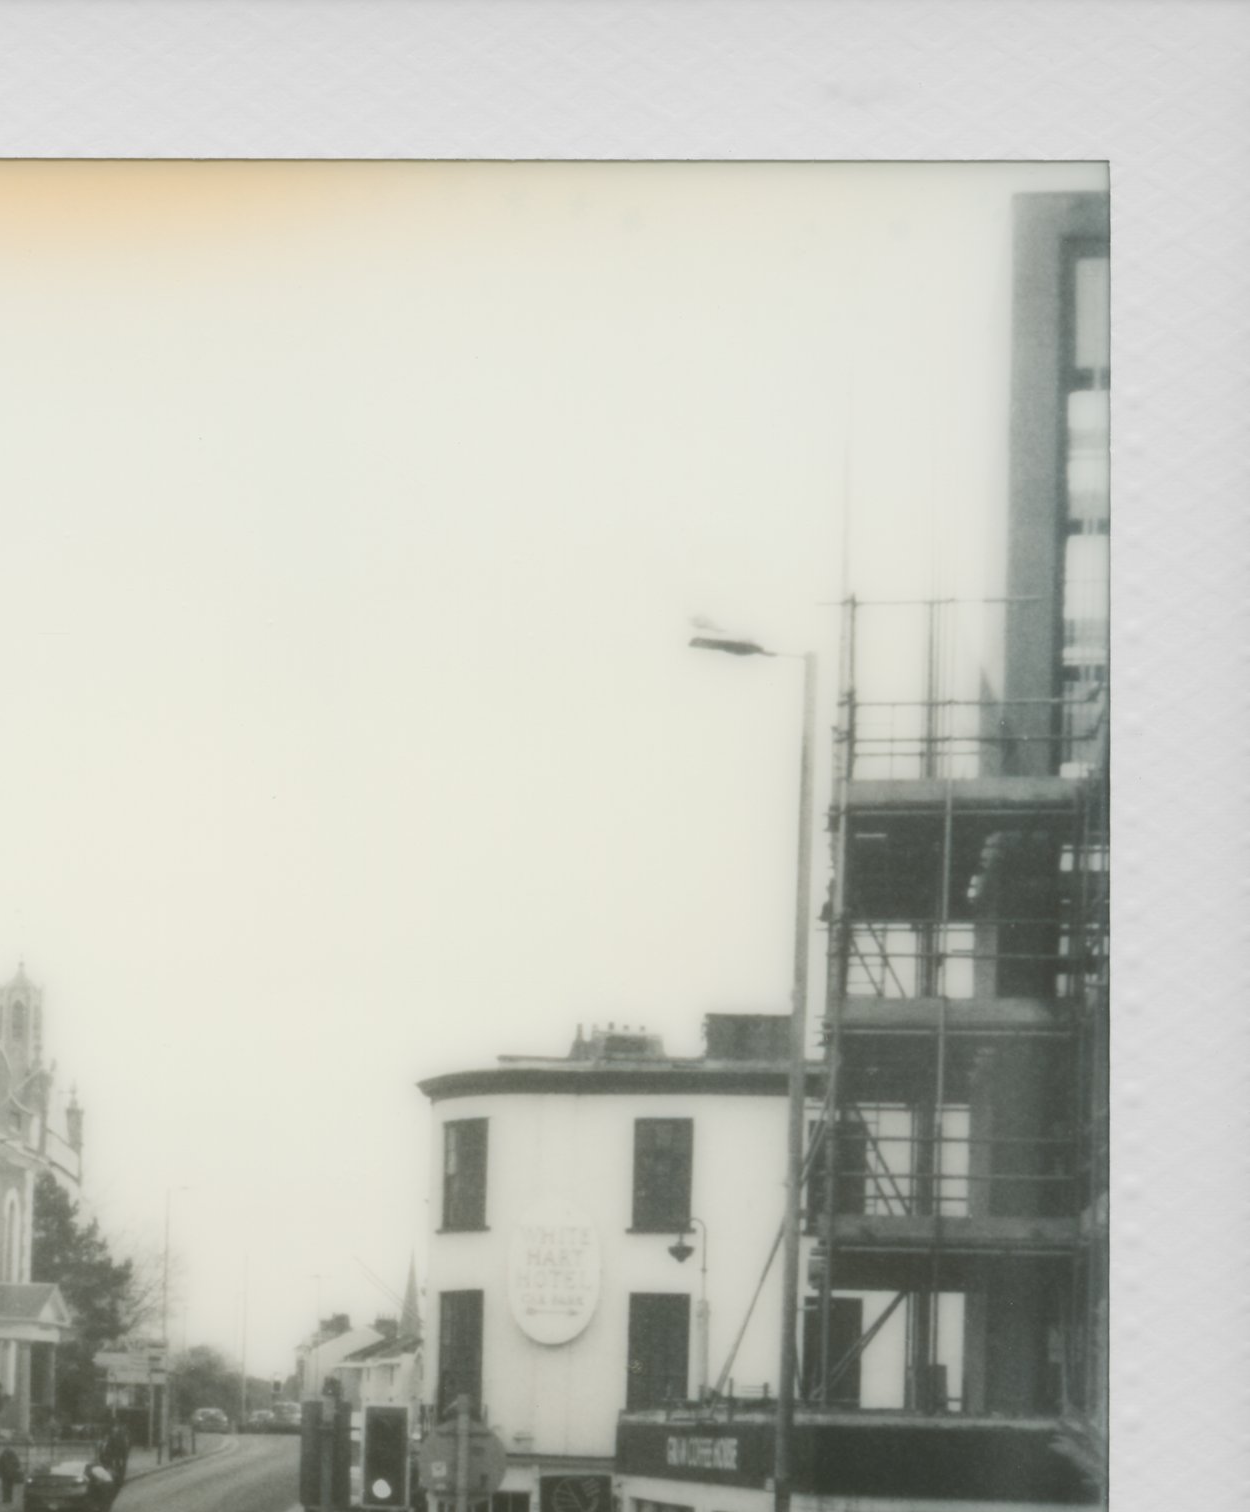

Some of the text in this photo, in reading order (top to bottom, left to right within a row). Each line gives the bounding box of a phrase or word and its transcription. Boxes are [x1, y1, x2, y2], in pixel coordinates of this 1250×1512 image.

[519, 1226, 591, 1246] WHITE
[526, 1247, 583, 1266] HART
[516, 1268, 592, 1289] HOTEL
